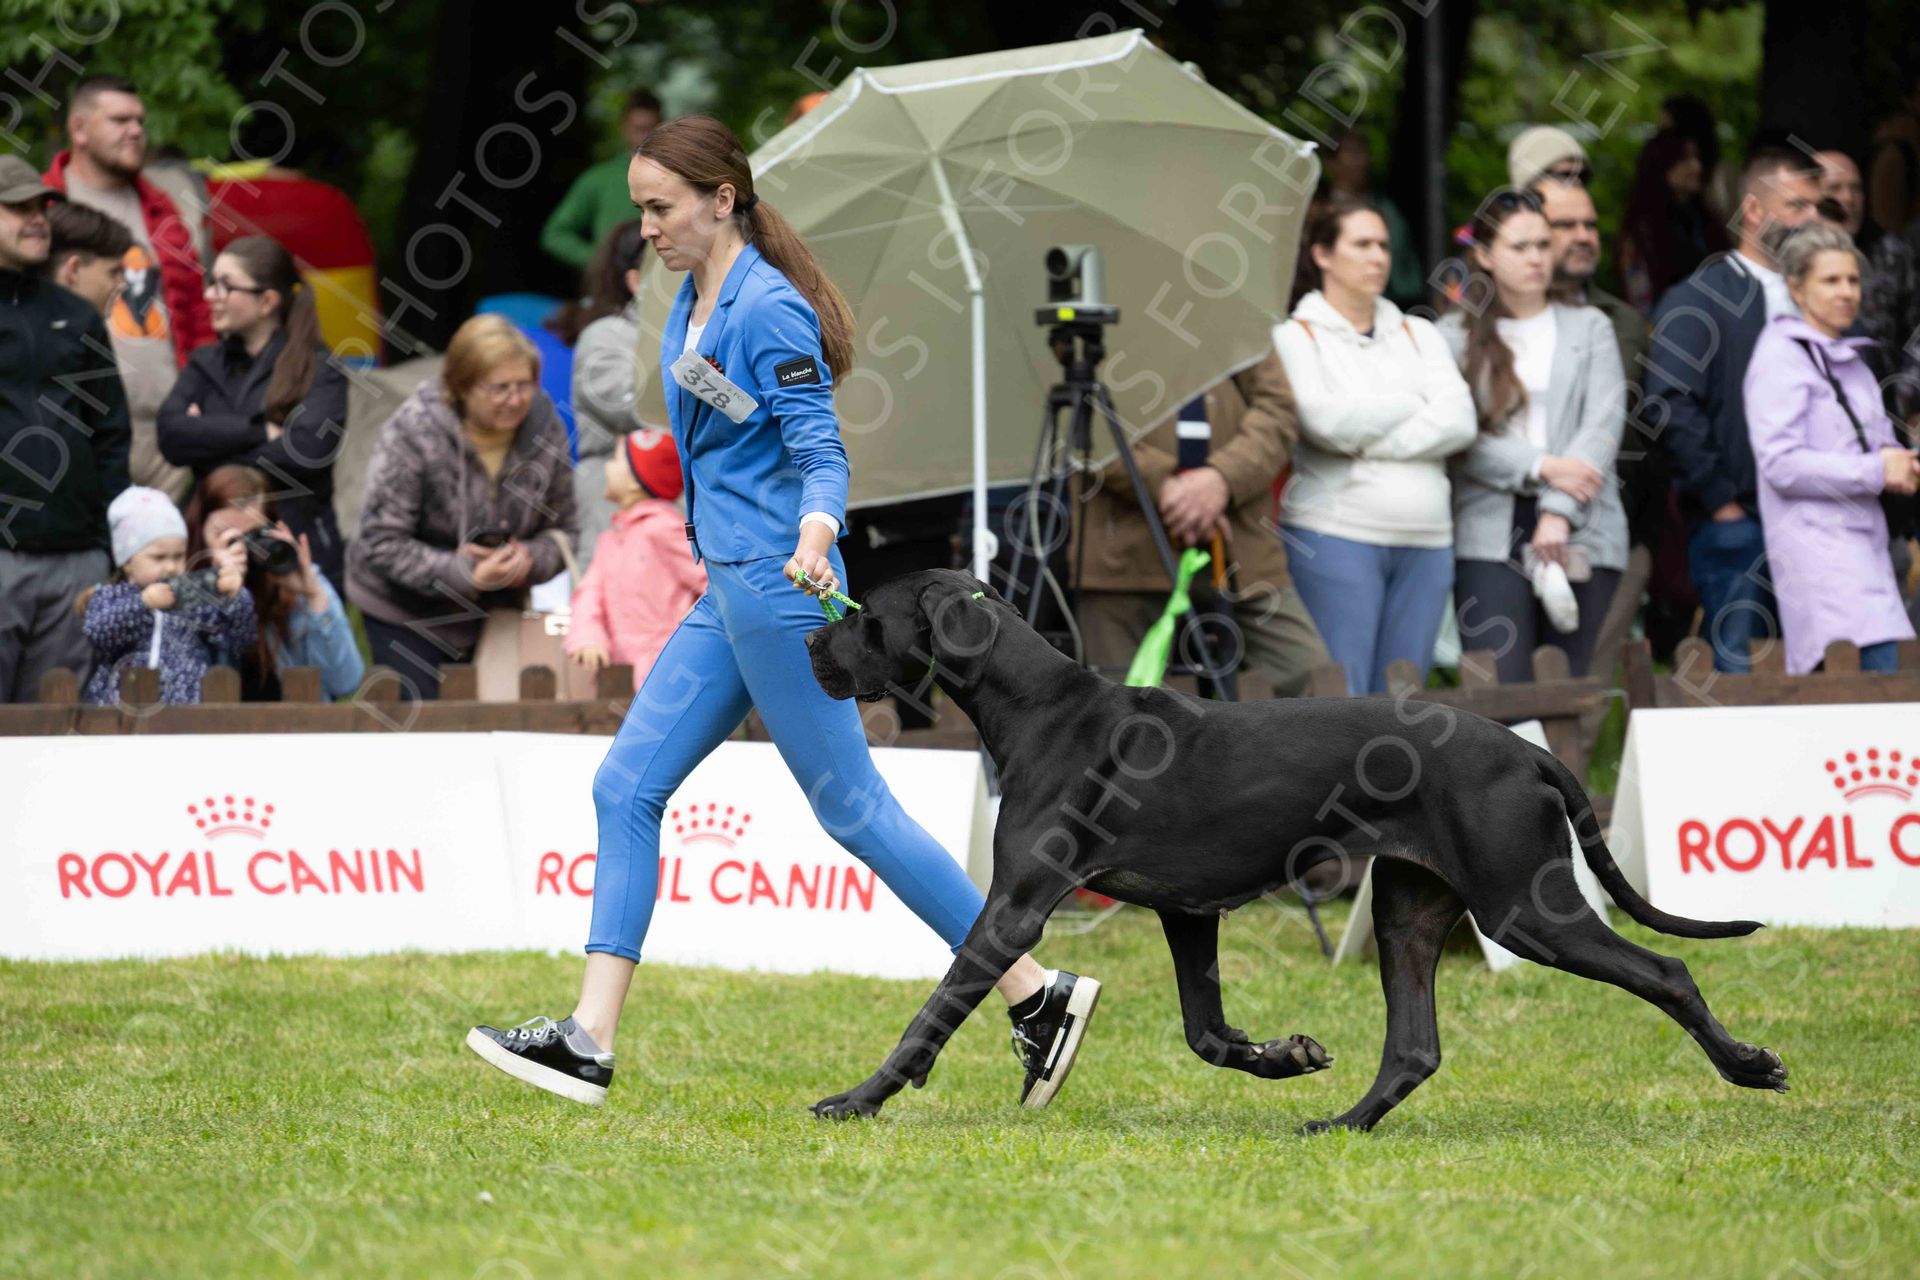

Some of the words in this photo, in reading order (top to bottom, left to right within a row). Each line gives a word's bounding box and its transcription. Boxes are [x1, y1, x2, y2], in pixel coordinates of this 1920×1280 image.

[683, 369, 731, 409] 378
[790, 367, 812, 378] blanche
[1677, 814, 1874, 875] ROYAL
[57, 850, 234, 899] ROYAL
[247, 848, 425, 896] CANIN
[536, 850, 691, 903] ROL
[709, 860, 877, 913] CANIN
